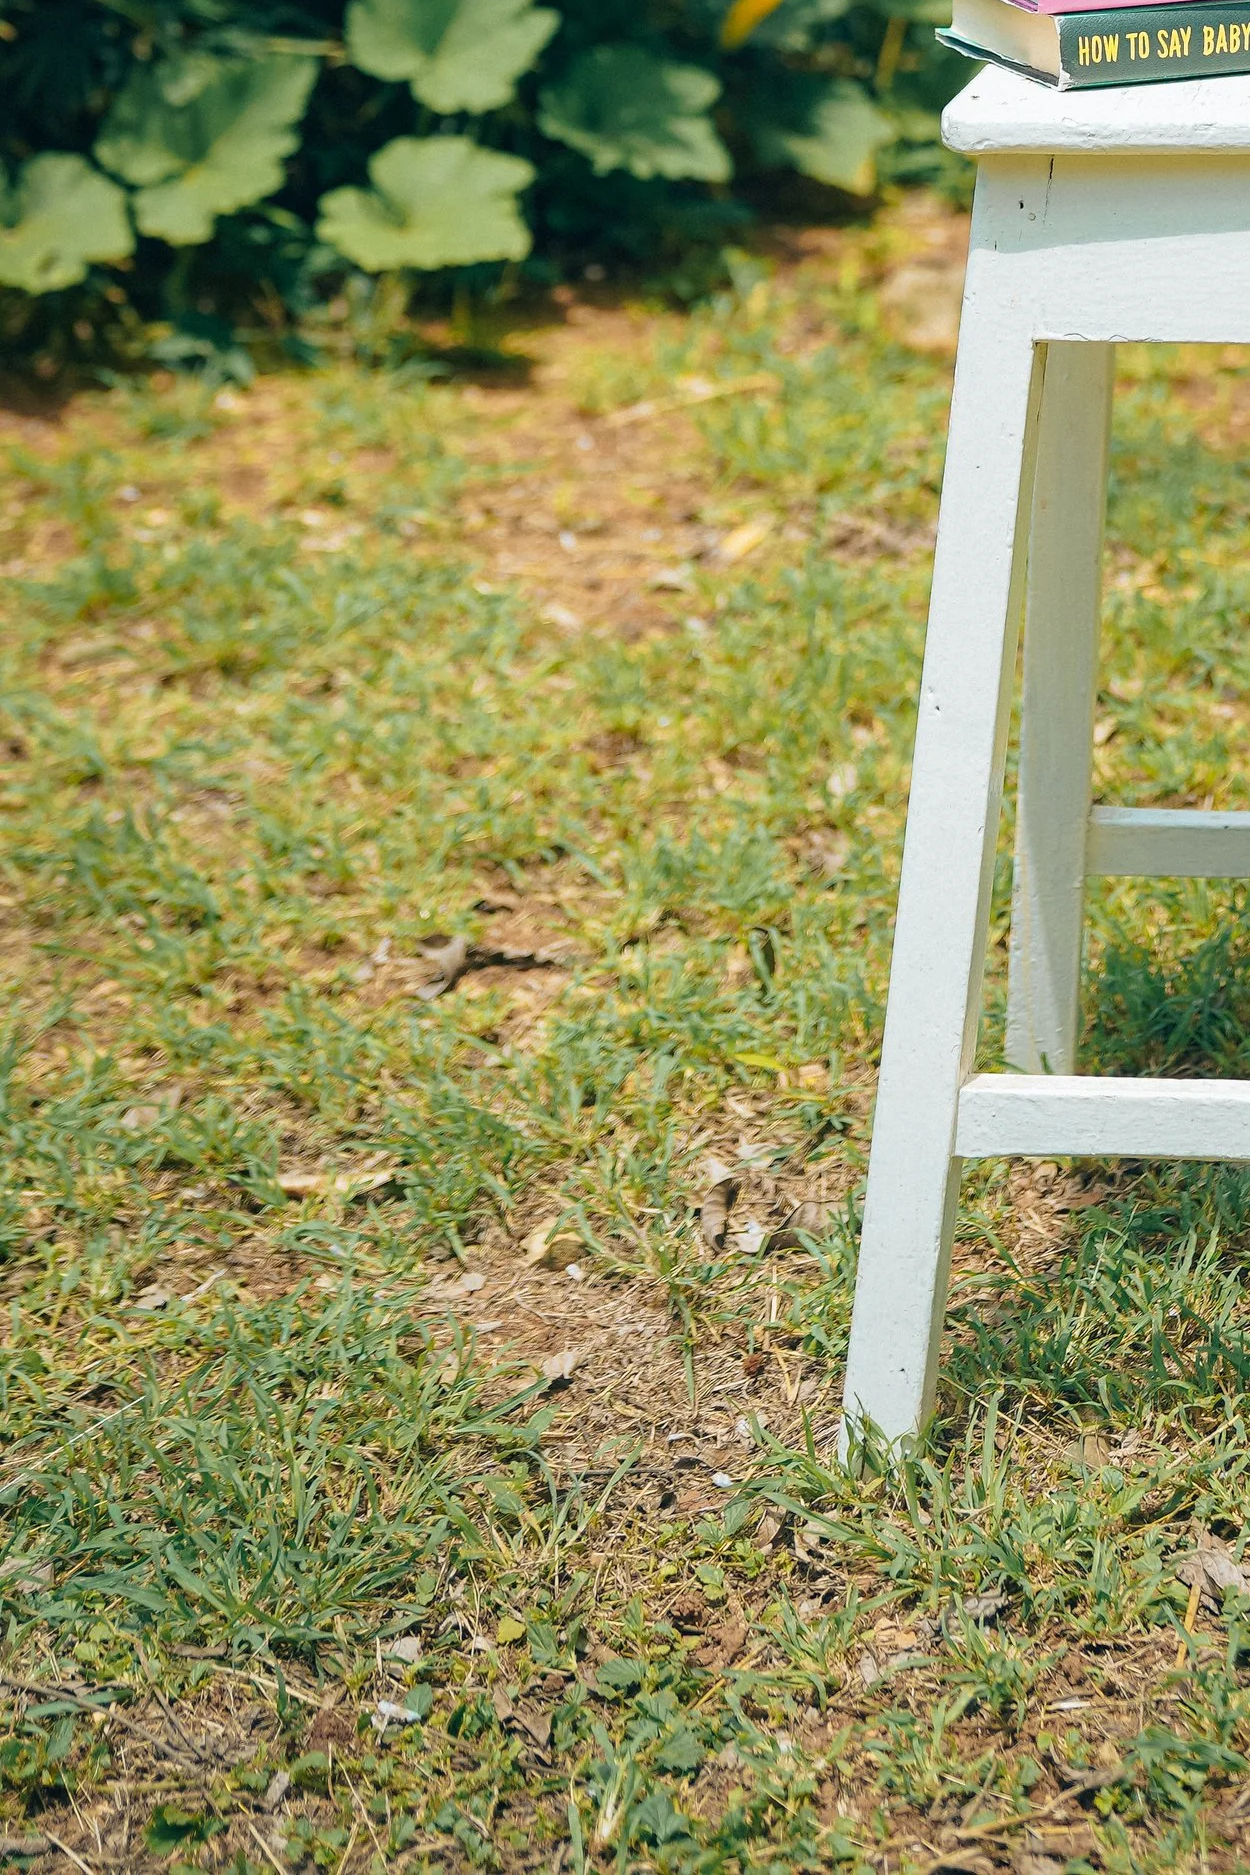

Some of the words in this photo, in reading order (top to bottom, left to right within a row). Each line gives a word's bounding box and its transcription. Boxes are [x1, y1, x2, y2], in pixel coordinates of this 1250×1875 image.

[1078, 33, 1119, 66] HOW
[1125, 31, 1150, 61] TO
[1157, 25, 1192, 59] SAY
